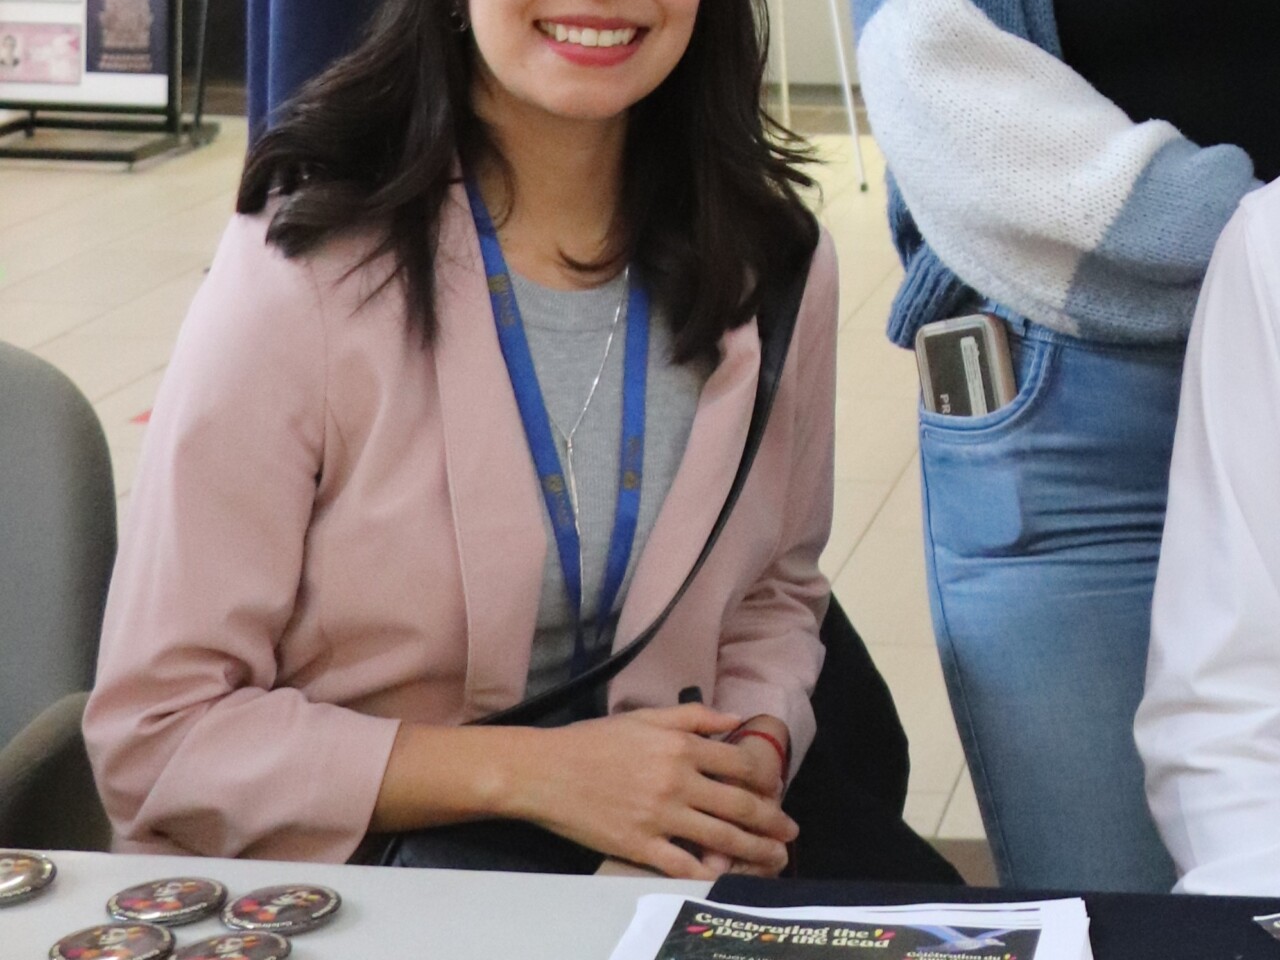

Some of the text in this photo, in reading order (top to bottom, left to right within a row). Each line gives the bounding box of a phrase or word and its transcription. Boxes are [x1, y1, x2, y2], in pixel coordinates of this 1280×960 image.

[695, 912, 870, 939] Celebrating the
[714, 925, 759, 942] Day
[792, 933, 828, 946] the
[832, 938, 891, 949] dead
